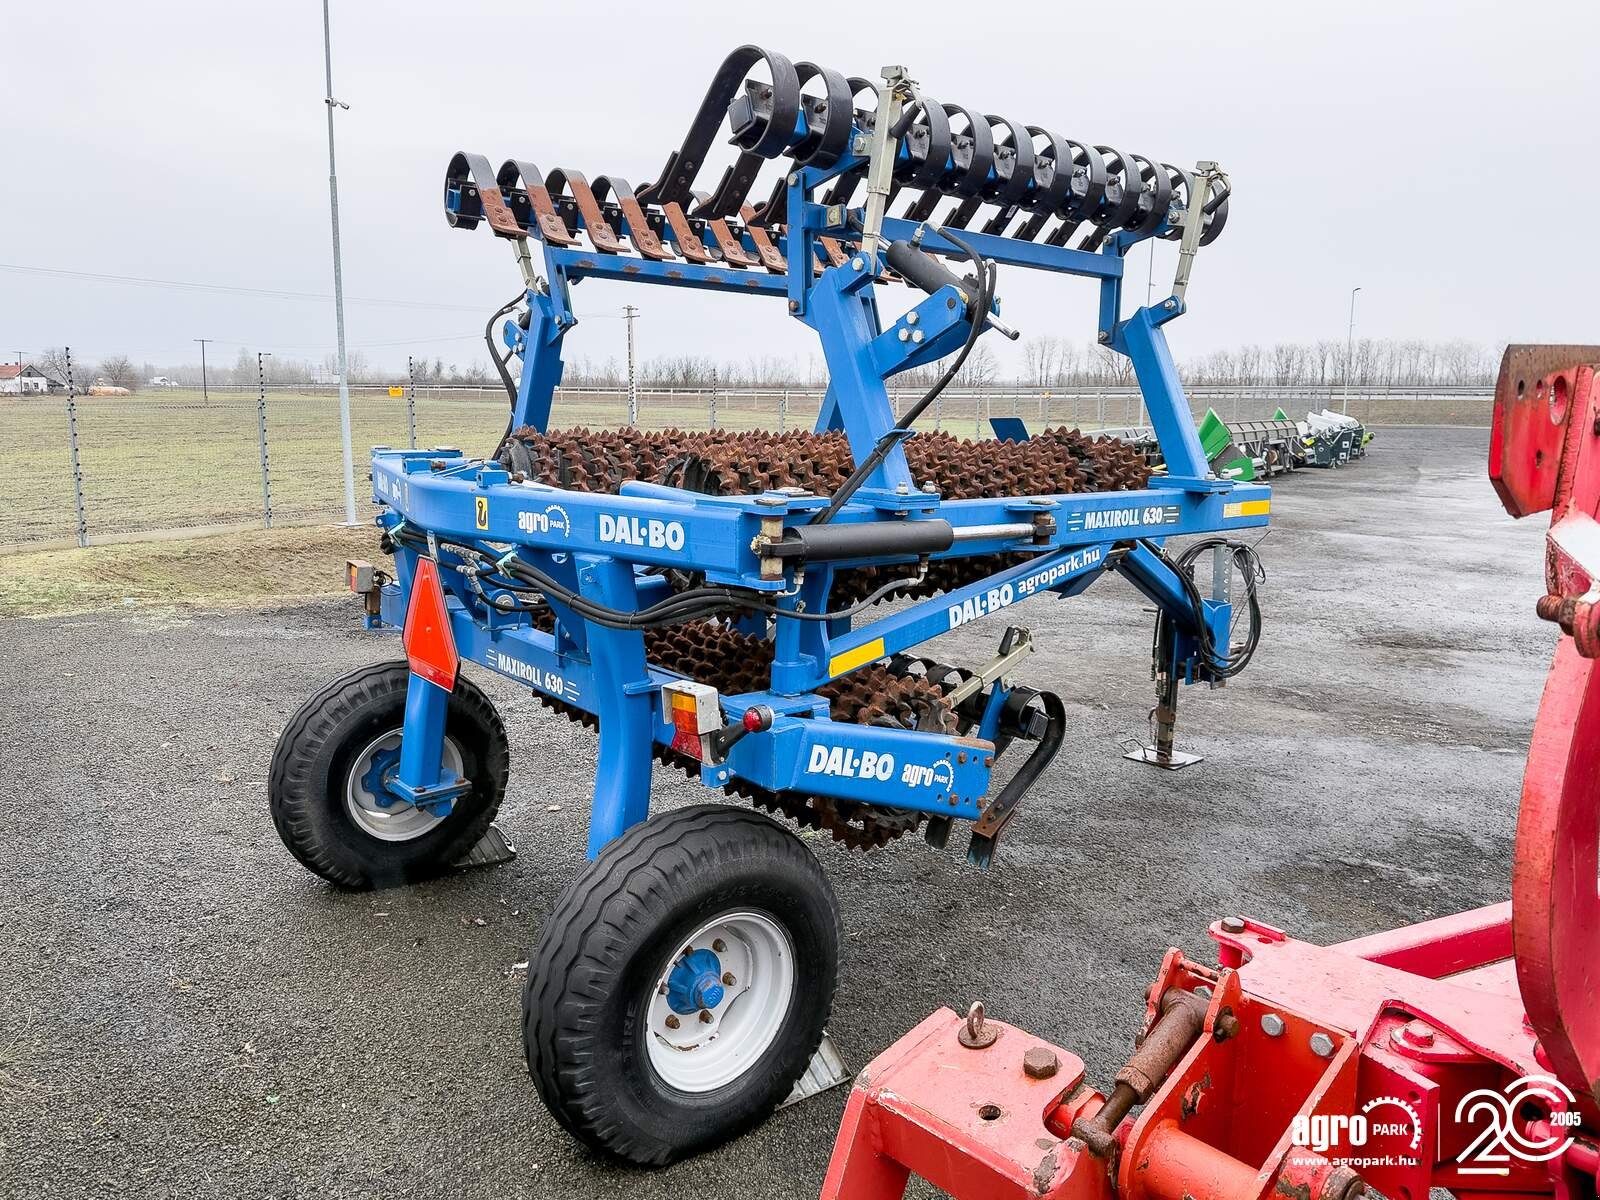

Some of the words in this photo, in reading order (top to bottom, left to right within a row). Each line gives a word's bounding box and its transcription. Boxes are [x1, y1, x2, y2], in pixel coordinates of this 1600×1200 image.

[518, 510, 549, 534] agro
[549, 519, 566, 530] PARK
[1084, 507, 1140, 529] MAXIROLL
[1143, 506, 1163, 525] 630
[1017, 549, 1100, 595] agropark.hu
[498, 652, 542, 687] MAXIROLL
[544, 673, 564, 695] 630
[902, 763, 935, 788] agro
[934, 774, 949, 784] PARK
